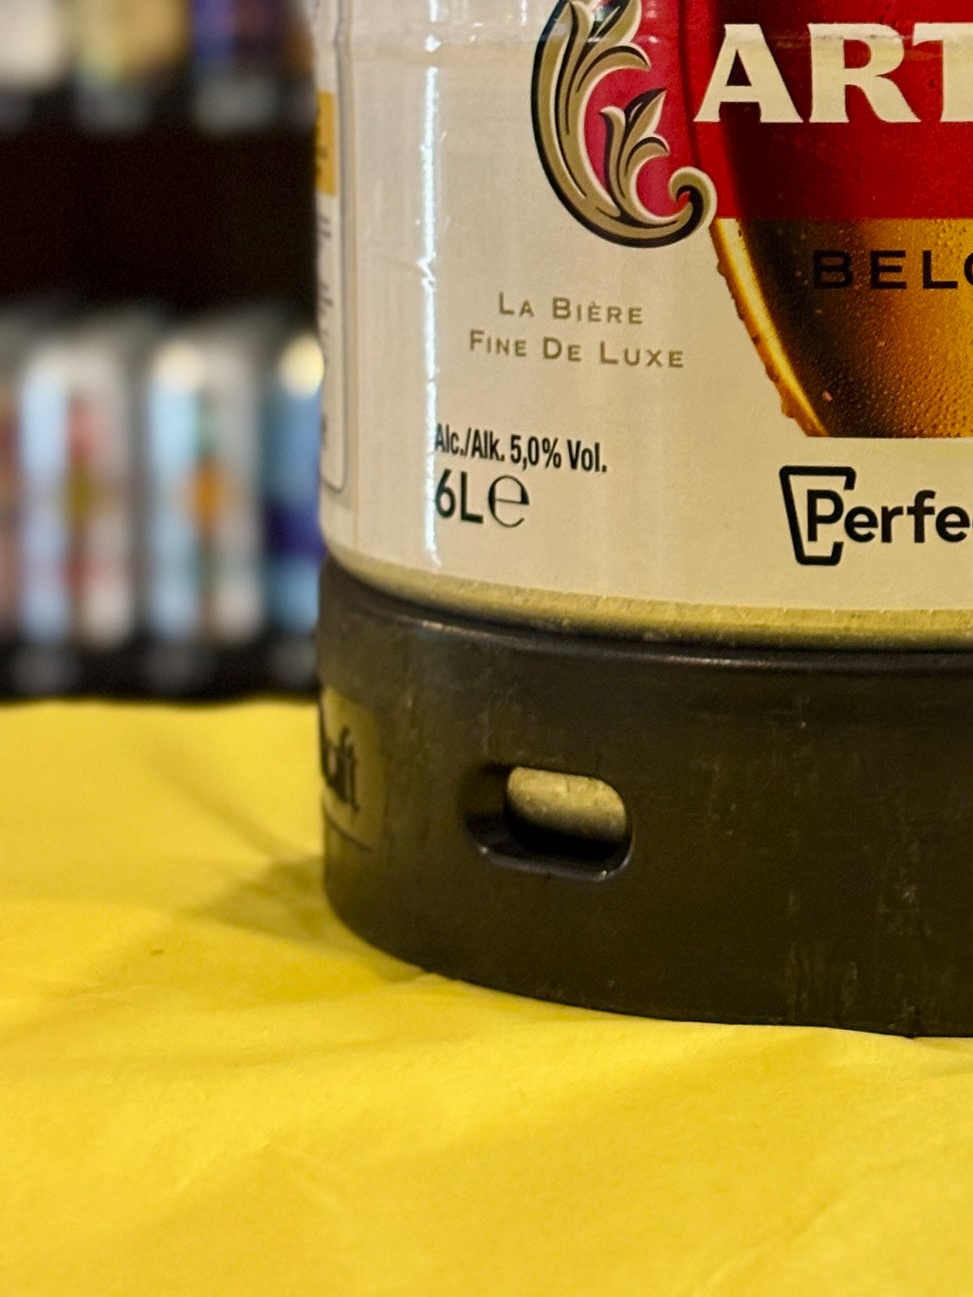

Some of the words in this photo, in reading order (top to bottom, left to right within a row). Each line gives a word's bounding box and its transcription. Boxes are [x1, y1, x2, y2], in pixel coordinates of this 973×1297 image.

[434, 422, 505, 462] Alc./Alk.
[510, 433, 563, 471] 5,0%
[567, 438, 608, 474] Vol.
